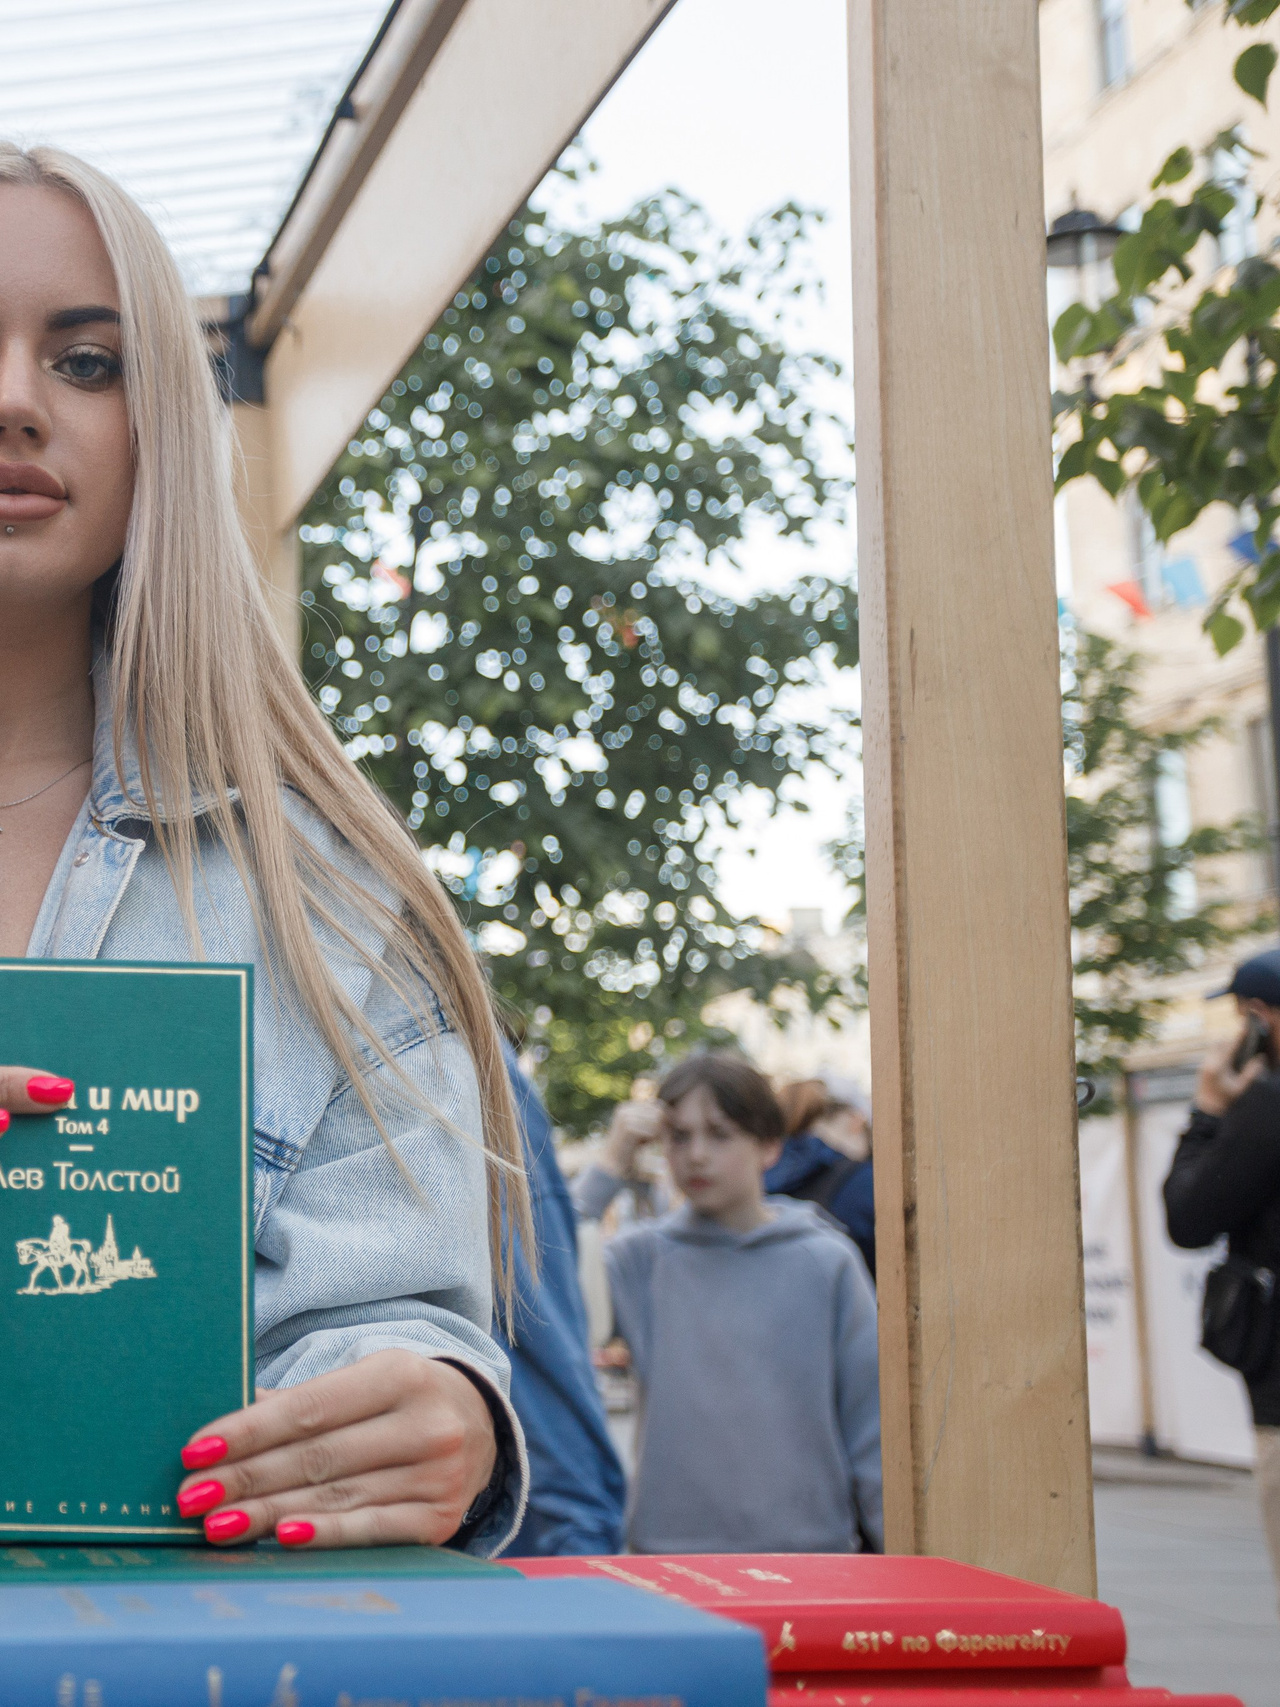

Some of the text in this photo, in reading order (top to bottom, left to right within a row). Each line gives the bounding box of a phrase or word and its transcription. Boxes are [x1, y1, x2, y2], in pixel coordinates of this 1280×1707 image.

[88, 1086, 111, 1111] и
[121, 1087, 200, 1124] мир
[54, 1115, 110, 1135] Том 4
[52, 1160, 181, 1194] Толстой
[57, 1501, 173, 1517] СТРАНИ
[901, 1634, 931, 1654] по
